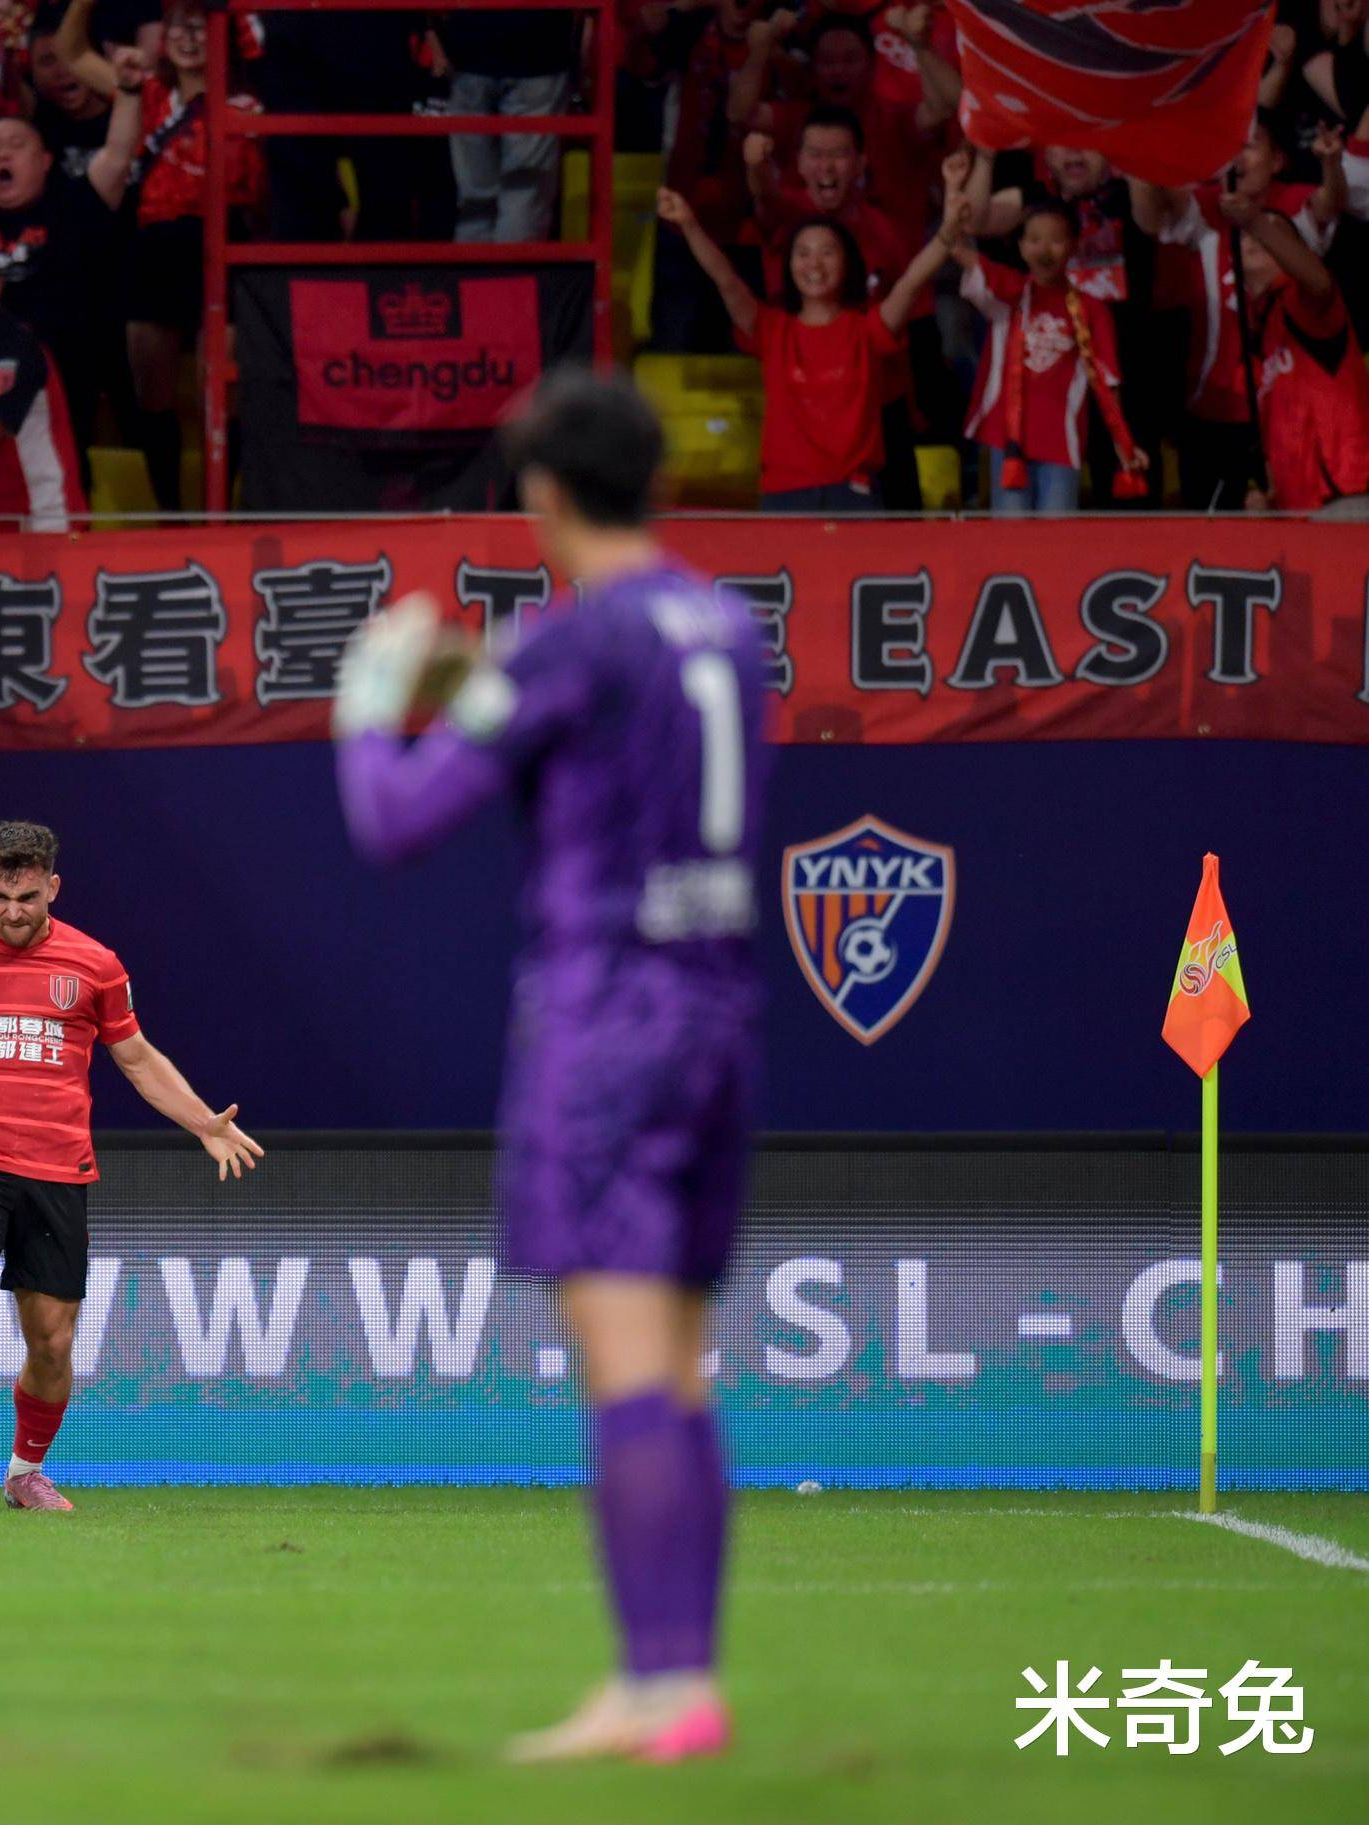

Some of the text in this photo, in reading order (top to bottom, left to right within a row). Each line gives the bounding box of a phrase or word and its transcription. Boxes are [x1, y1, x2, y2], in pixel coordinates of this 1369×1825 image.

[324, 349, 515, 403] chengdu
[457, 557, 793, 697] TE
[850, 557, 1283, 697] EAST
[681, 652, 745, 854] 1
[800, 857, 937, 887] YNYK
